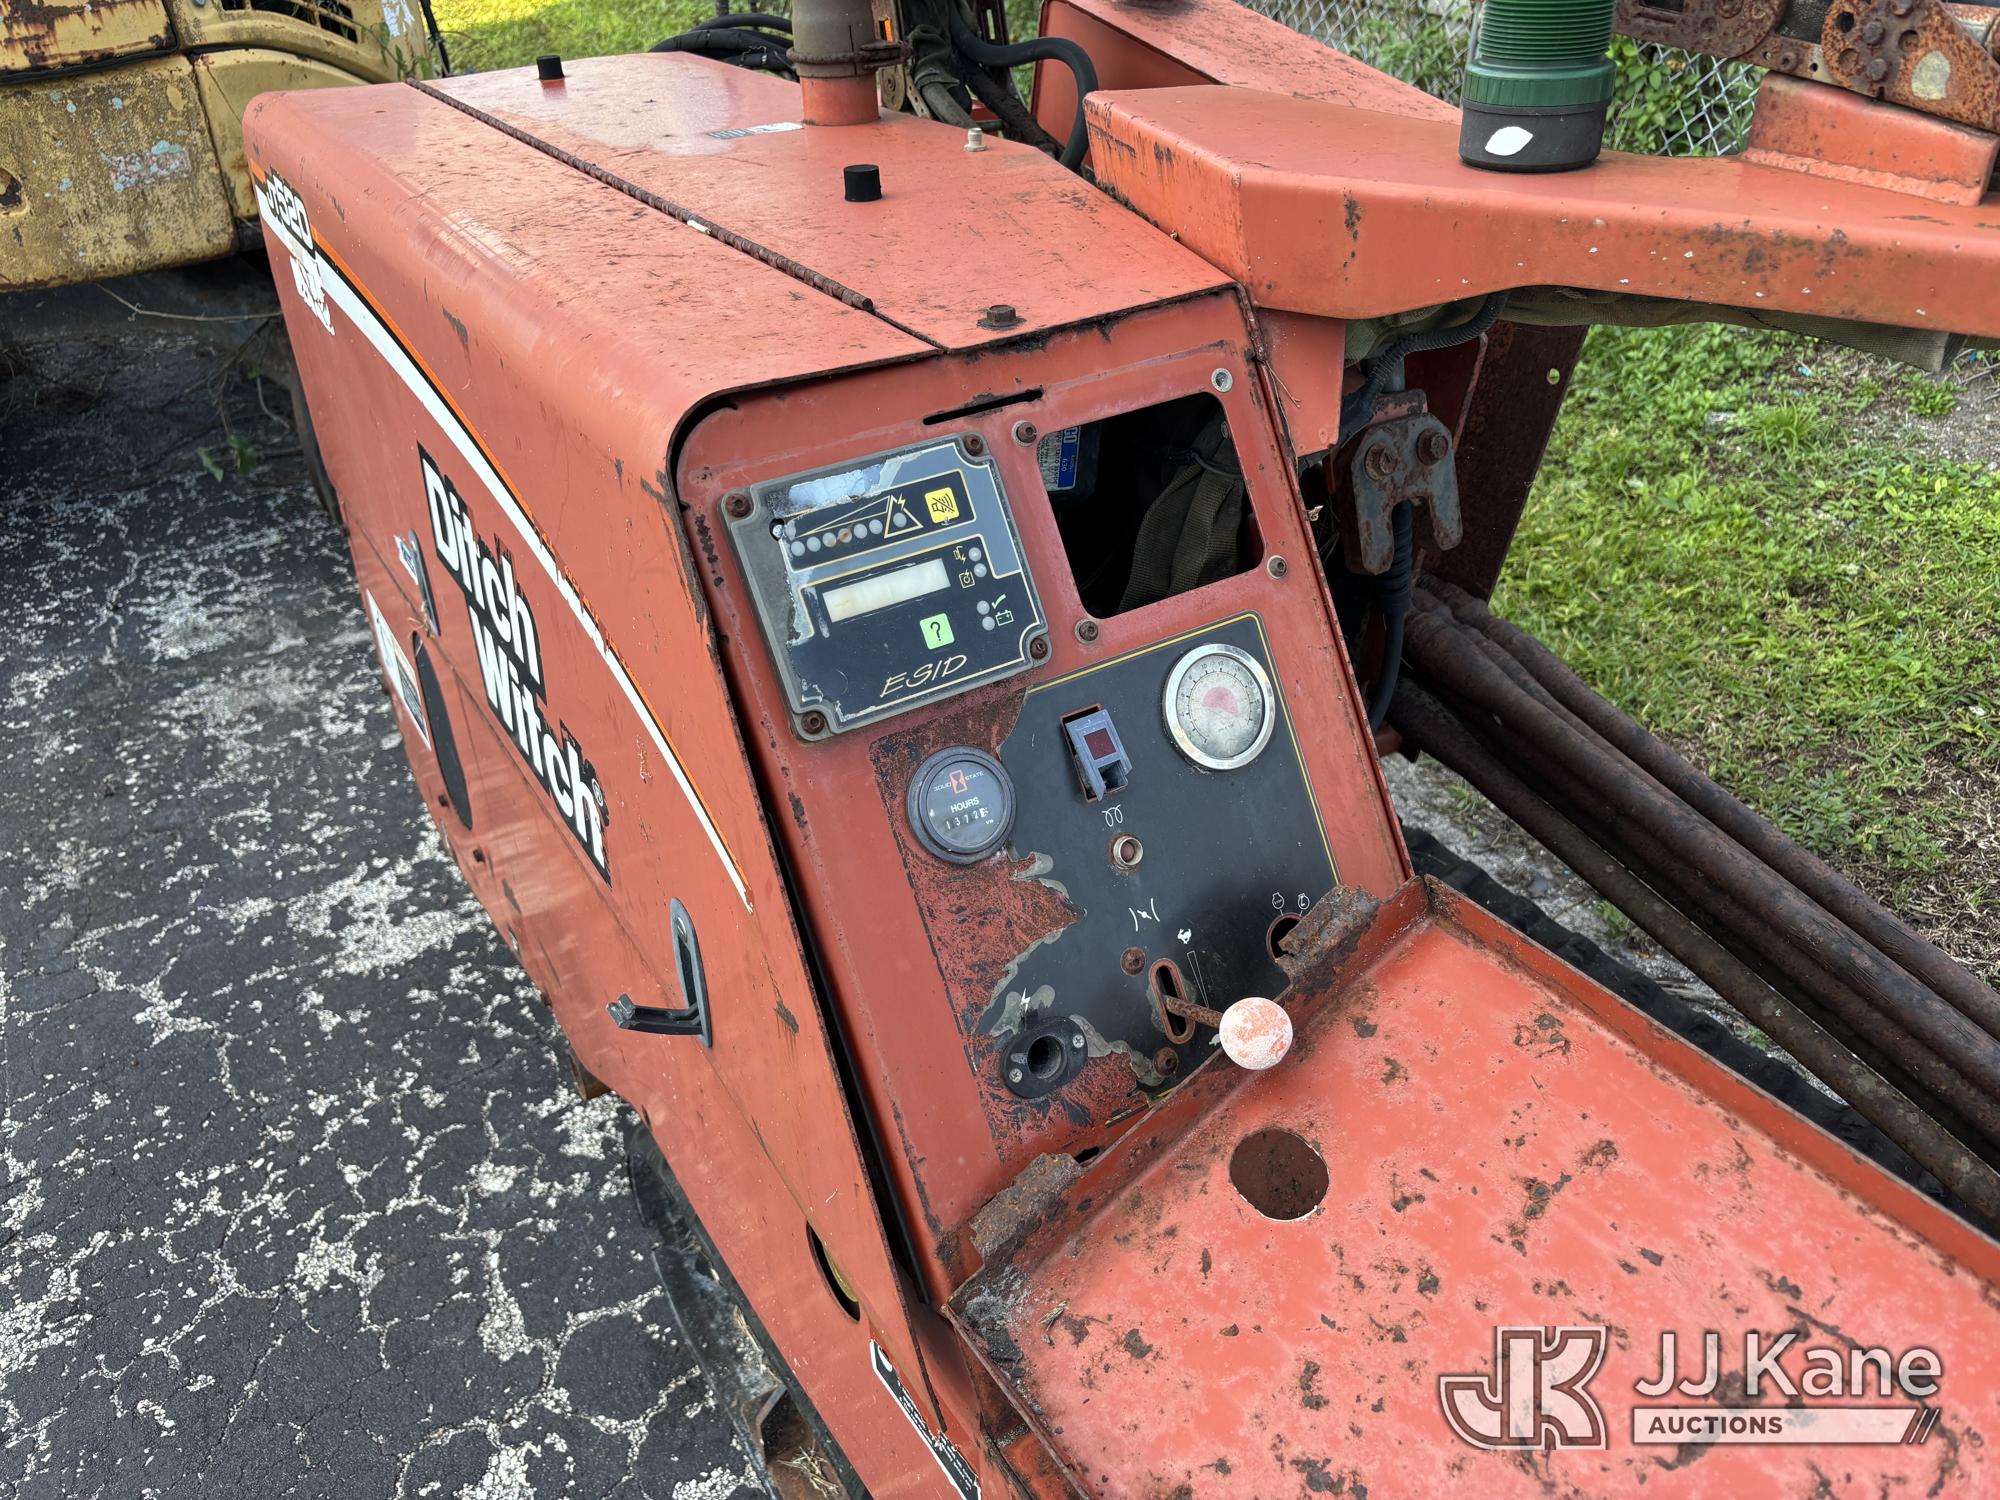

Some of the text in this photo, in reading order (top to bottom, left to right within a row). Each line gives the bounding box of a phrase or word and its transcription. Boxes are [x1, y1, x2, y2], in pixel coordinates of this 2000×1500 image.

[422, 458, 541, 686] Ditch
[467, 605, 606, 868] Witch
[879, 654, 968, 698] ESID
[950, 796, 980, 813] HOURS
